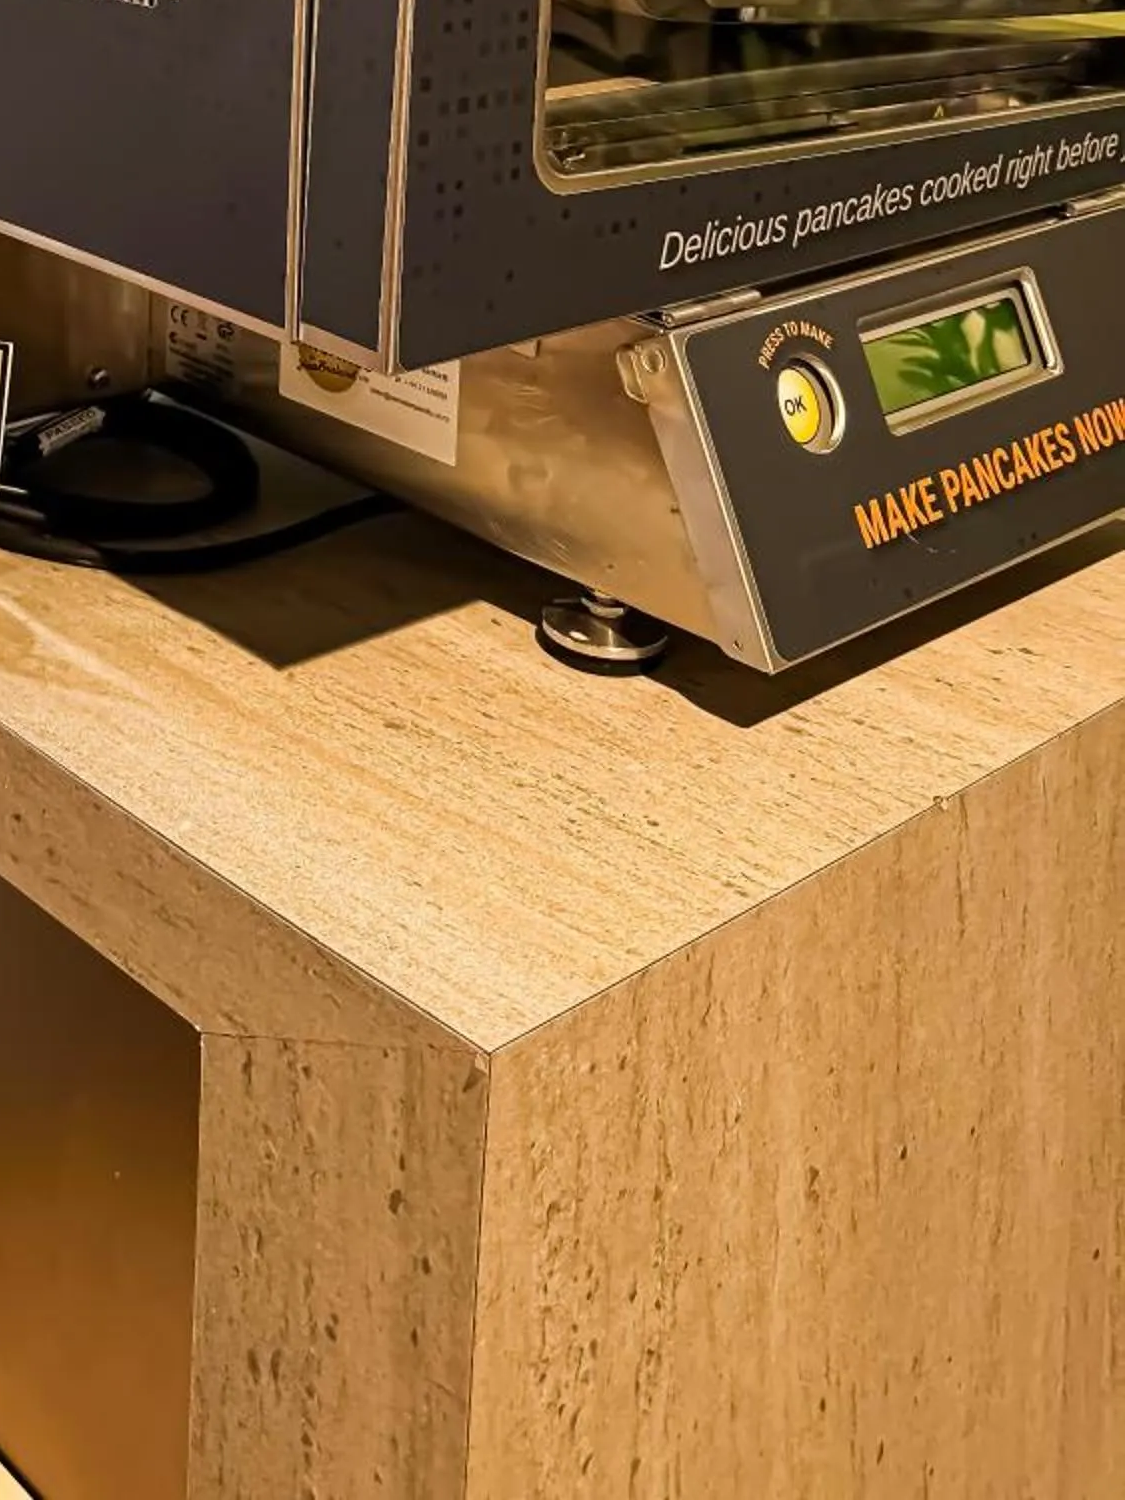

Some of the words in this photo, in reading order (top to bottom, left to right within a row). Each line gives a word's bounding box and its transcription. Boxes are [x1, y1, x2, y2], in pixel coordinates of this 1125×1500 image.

[659, 213, 788, 271] Delicious
[792, 183, 915, 249] pancakes
[920, 153, 1004, 206] cooked
[1004, 144, 1054, 189] right
[1056, 131, 1120, 172] before
[758, 327, 785, 371] PRESS
[782, 321, 798, 337] TO
[800, 321, 834, 349] MAKE
[784, 396, 807, 417] OK
[853, 476, 944, 549] MAKE
[939, 422, 1076, 514] PANCAKES
